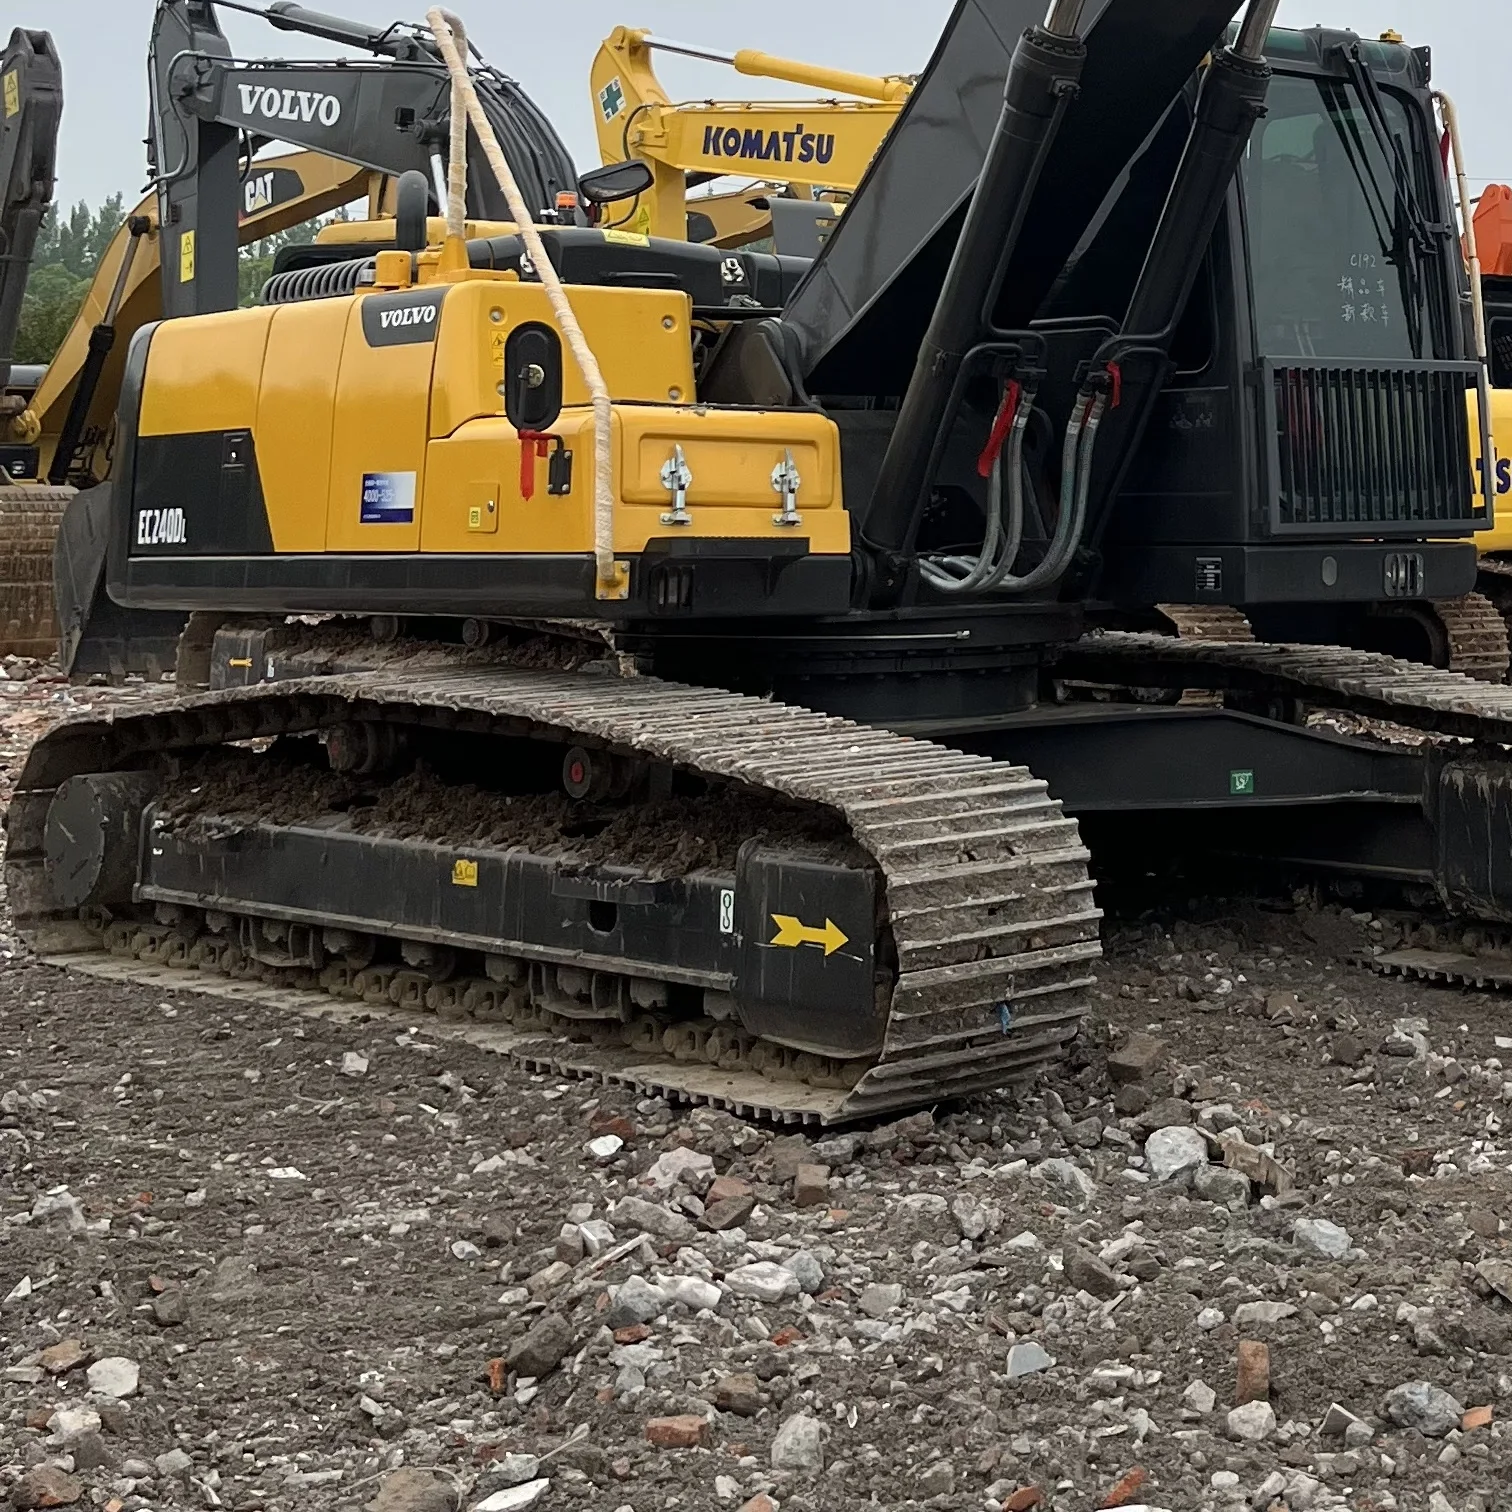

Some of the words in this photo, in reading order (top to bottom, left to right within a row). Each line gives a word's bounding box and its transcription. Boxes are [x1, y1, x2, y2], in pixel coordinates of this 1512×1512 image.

[237, 83, 341, 127] VOLVO
[702, 123, 835, 165] KOMATSU
[244, 171, 275, 213] CAT
[1350, 253, 1376, 269] C192
[380, 304, 437, 329] VOLVO
